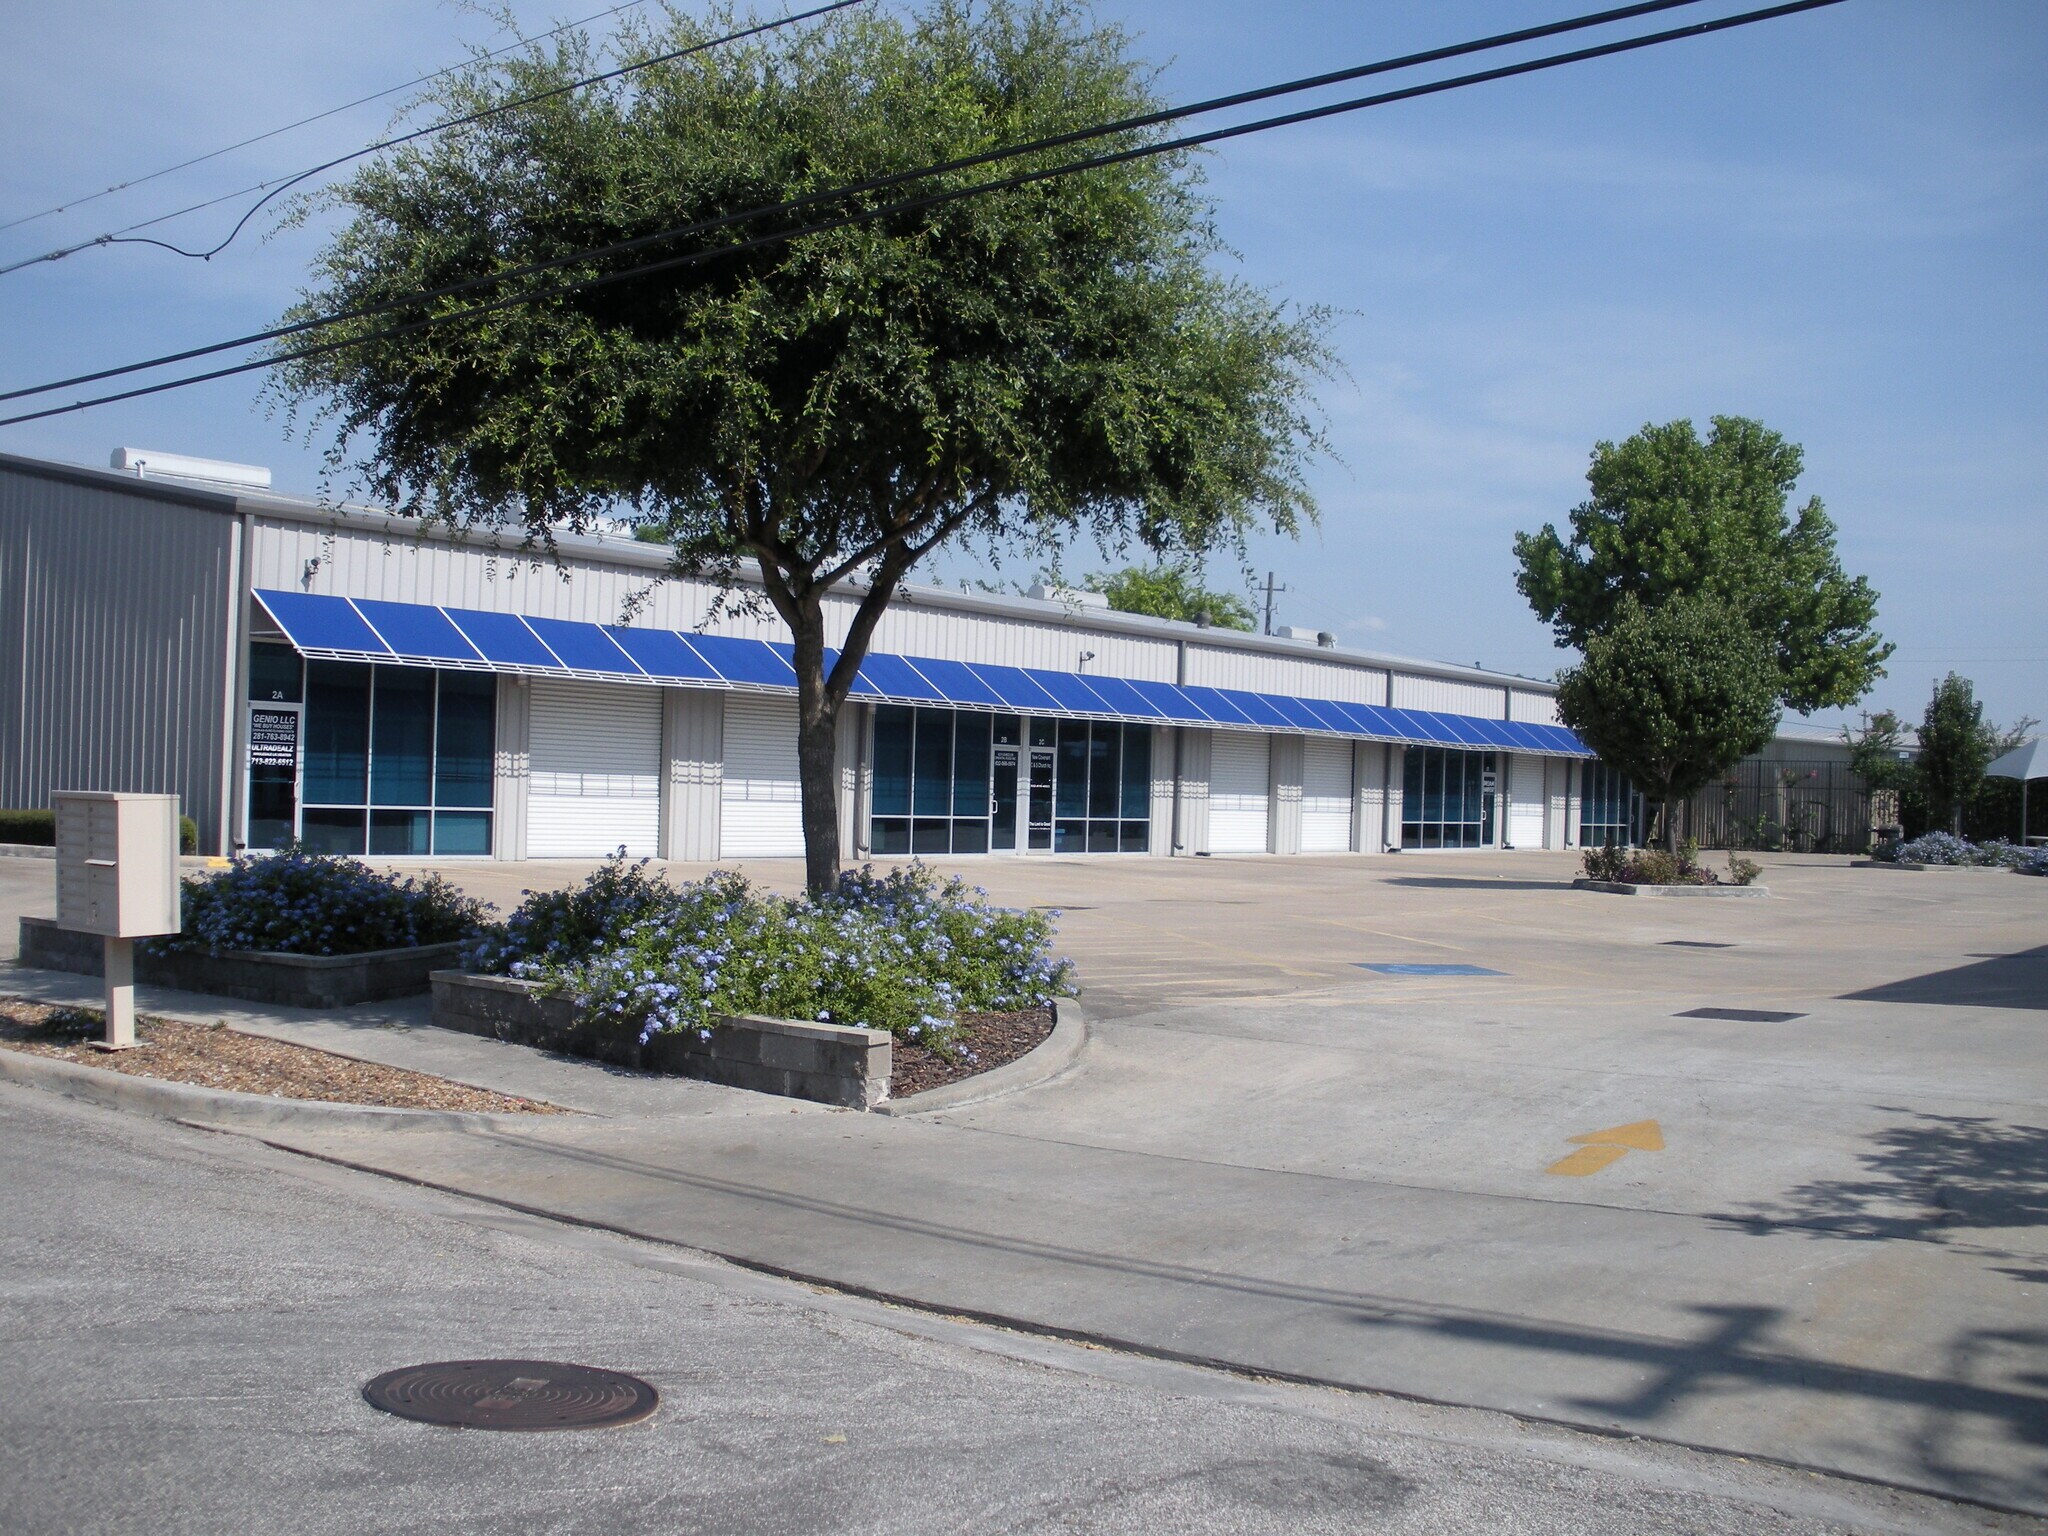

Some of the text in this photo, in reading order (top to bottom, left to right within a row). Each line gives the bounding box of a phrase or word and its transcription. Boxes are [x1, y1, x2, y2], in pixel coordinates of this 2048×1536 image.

[272, 690, 283, 699] 2A
[253, 715, 296, 724] GENIO LLC
[252, 732, 295, 741] 281-763-8942
[251, 744, 294, 752] ULTRADEALZ
